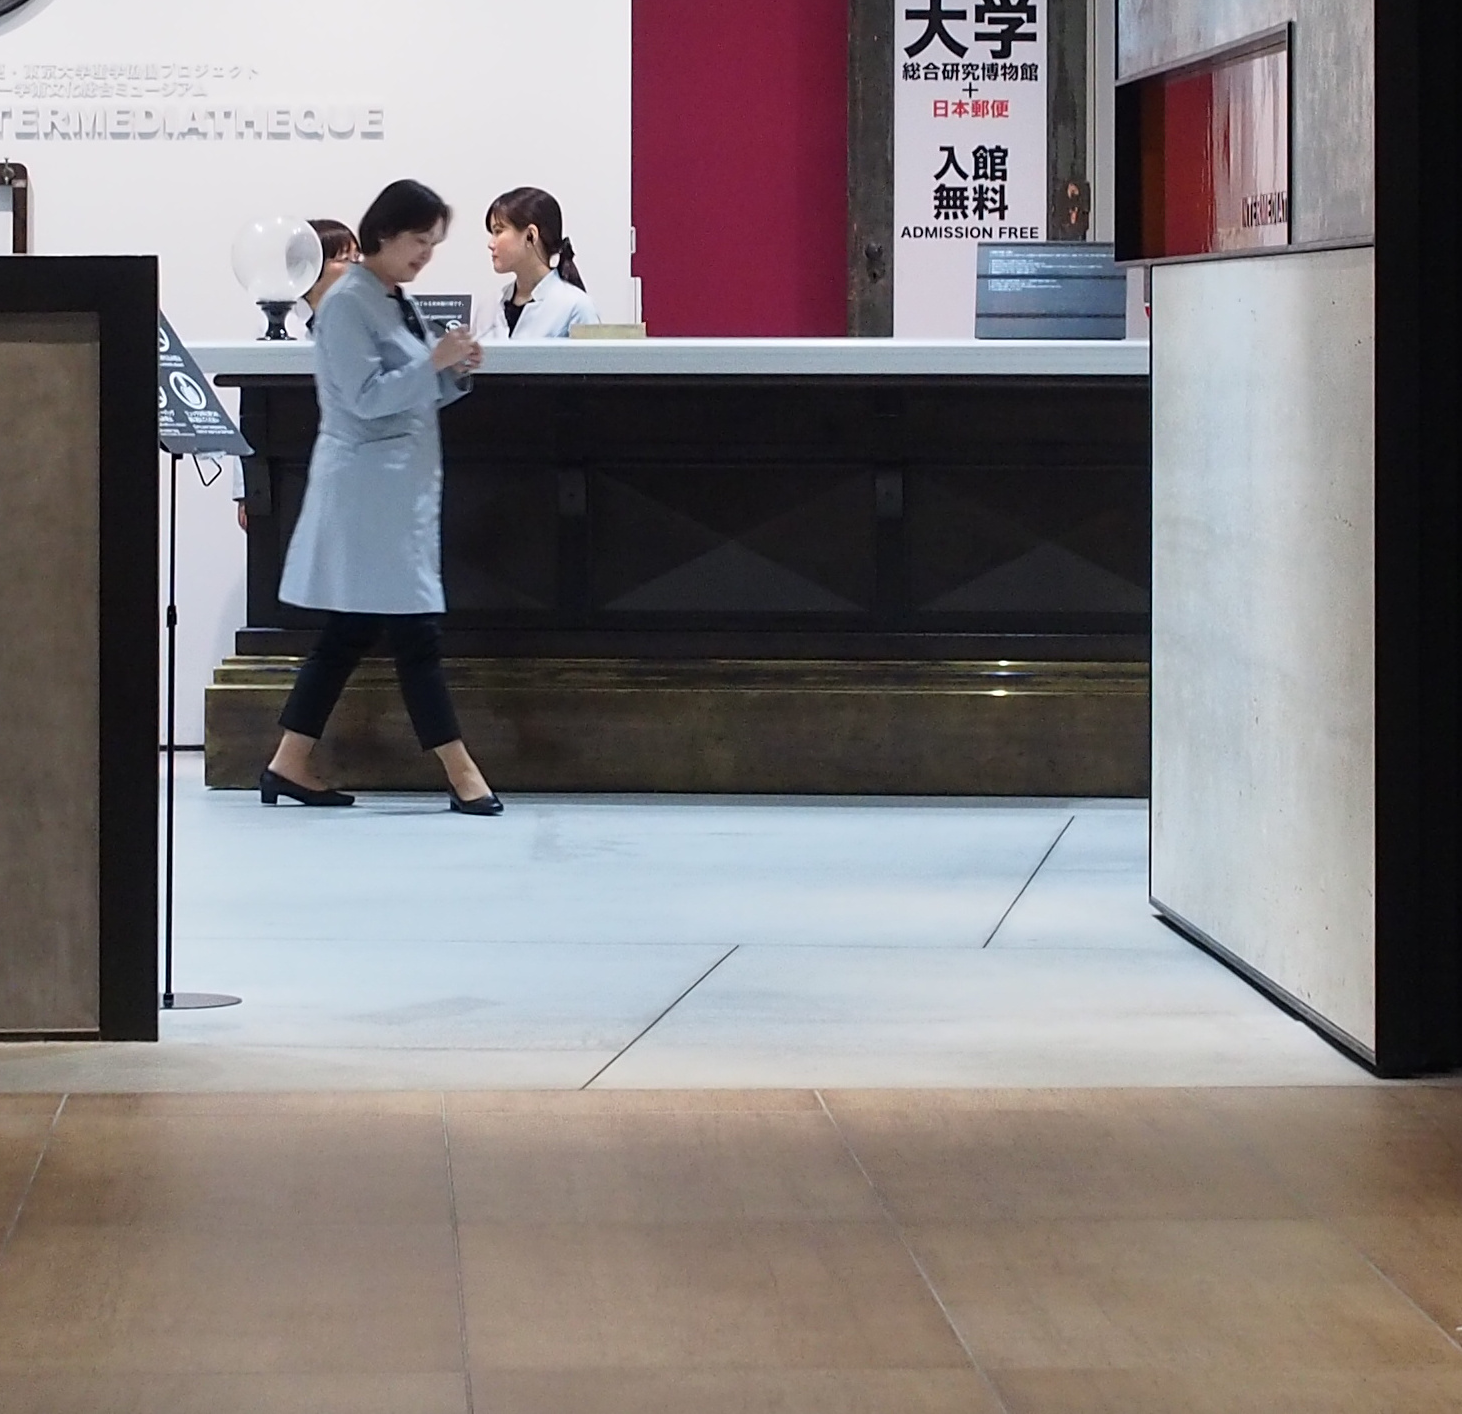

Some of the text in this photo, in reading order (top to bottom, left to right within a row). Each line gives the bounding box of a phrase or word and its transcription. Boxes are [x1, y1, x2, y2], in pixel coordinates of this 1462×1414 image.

[902, 63, 1039, 82] 総合研究博物館
[933, 99, 1010, 119] 日本郵便
[933, 145, 1009, 182] 入館
[933, 183, 1009, 221] 無料
[900, 225, 1040, 239] ADMISSION FREE
